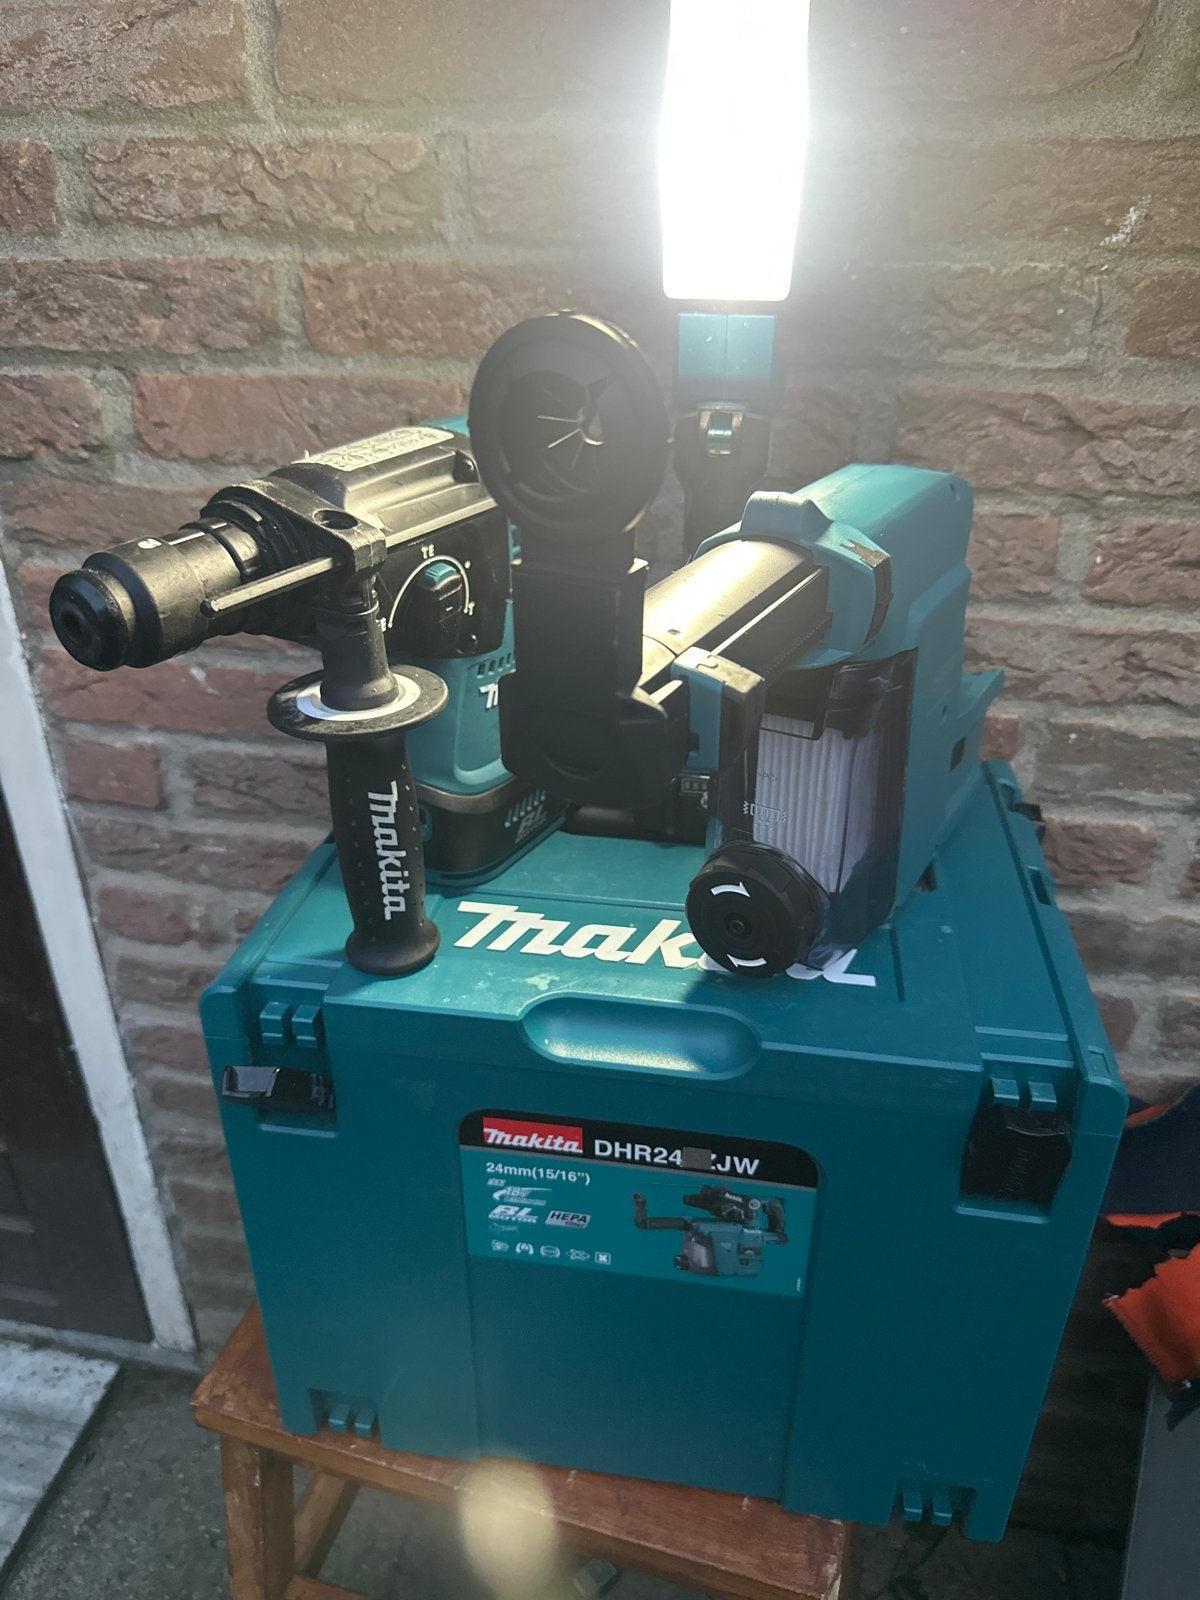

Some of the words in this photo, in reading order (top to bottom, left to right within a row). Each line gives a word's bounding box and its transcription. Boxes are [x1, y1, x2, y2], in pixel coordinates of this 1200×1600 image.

[368, 781, 410, 920] Makita
[483, 1127, 583, 1153] Makita
[595, 1139, 759, 1175] DHR24JW
[550, 1211, 587, 1223] HEPA
